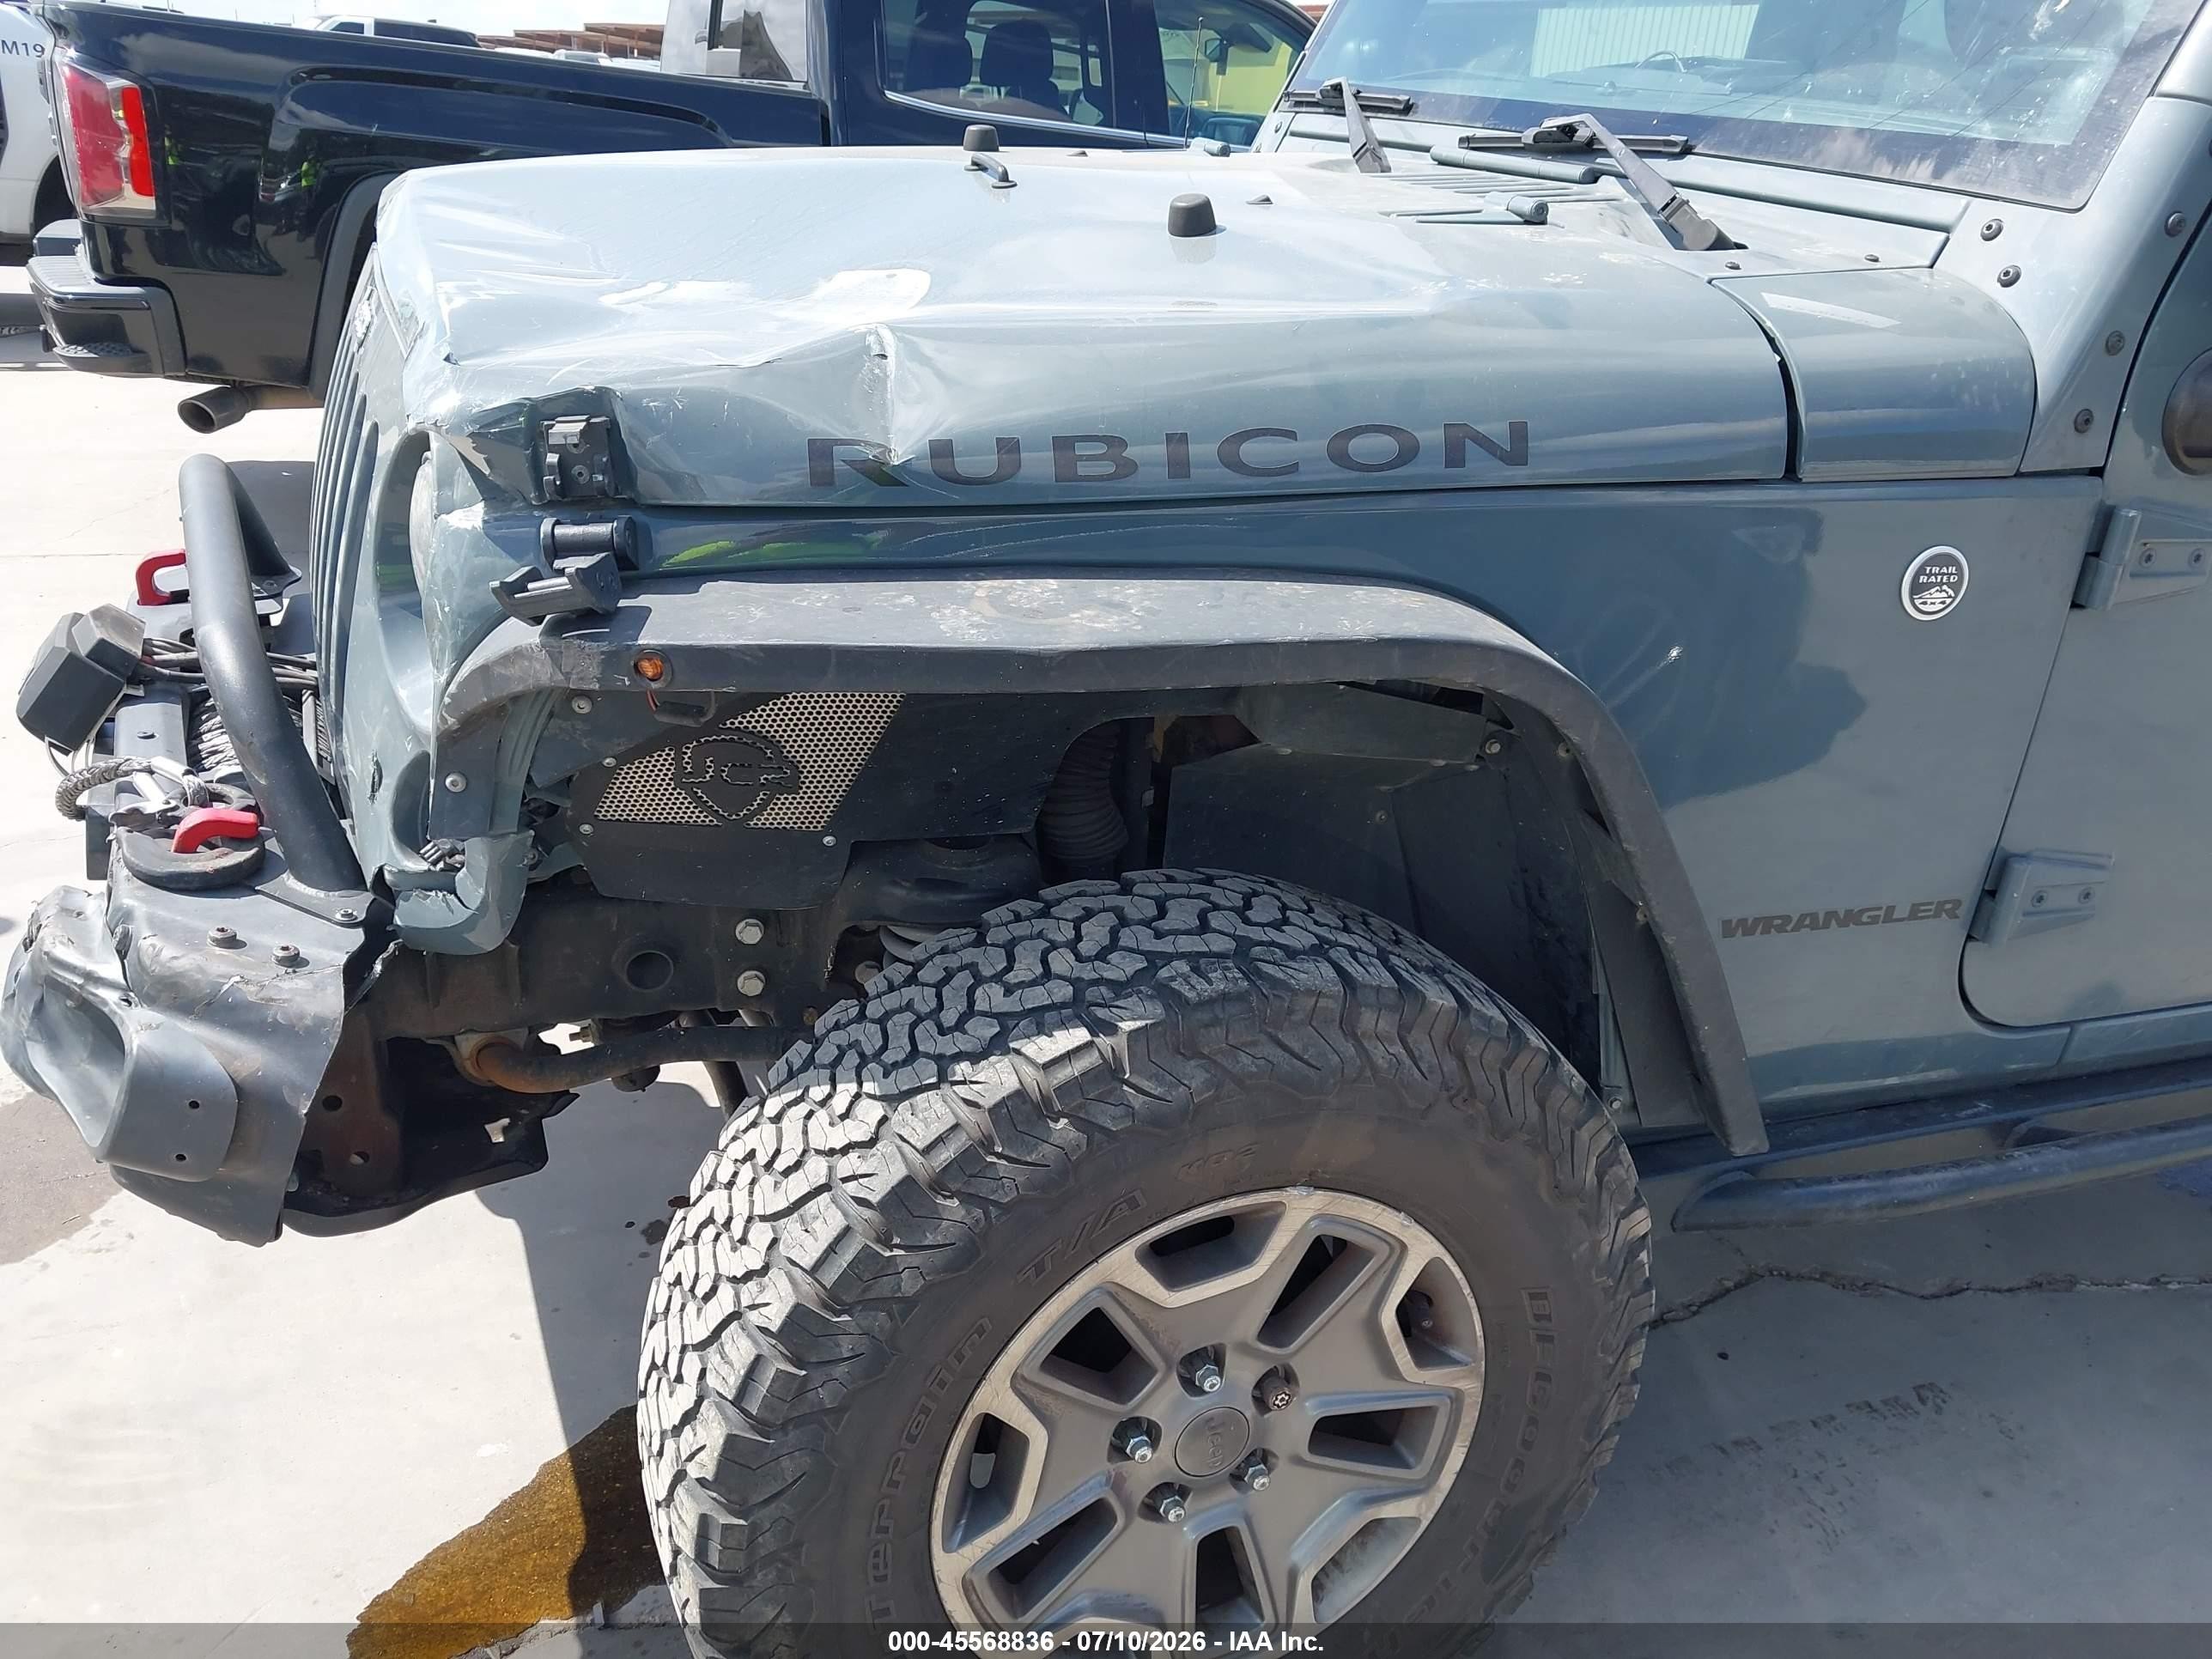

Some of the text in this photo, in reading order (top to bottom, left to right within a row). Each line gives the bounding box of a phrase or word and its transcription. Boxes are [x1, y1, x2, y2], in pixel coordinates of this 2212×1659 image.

[1, 40, 46, 58] M19
[806, 421, 1530, 488] RUBICON
[1918, 574, 1959, 584] RATED
[1924, 566, 1959, 574] TRAIL
[1720, 898, 1964, 939] WRANGLER
